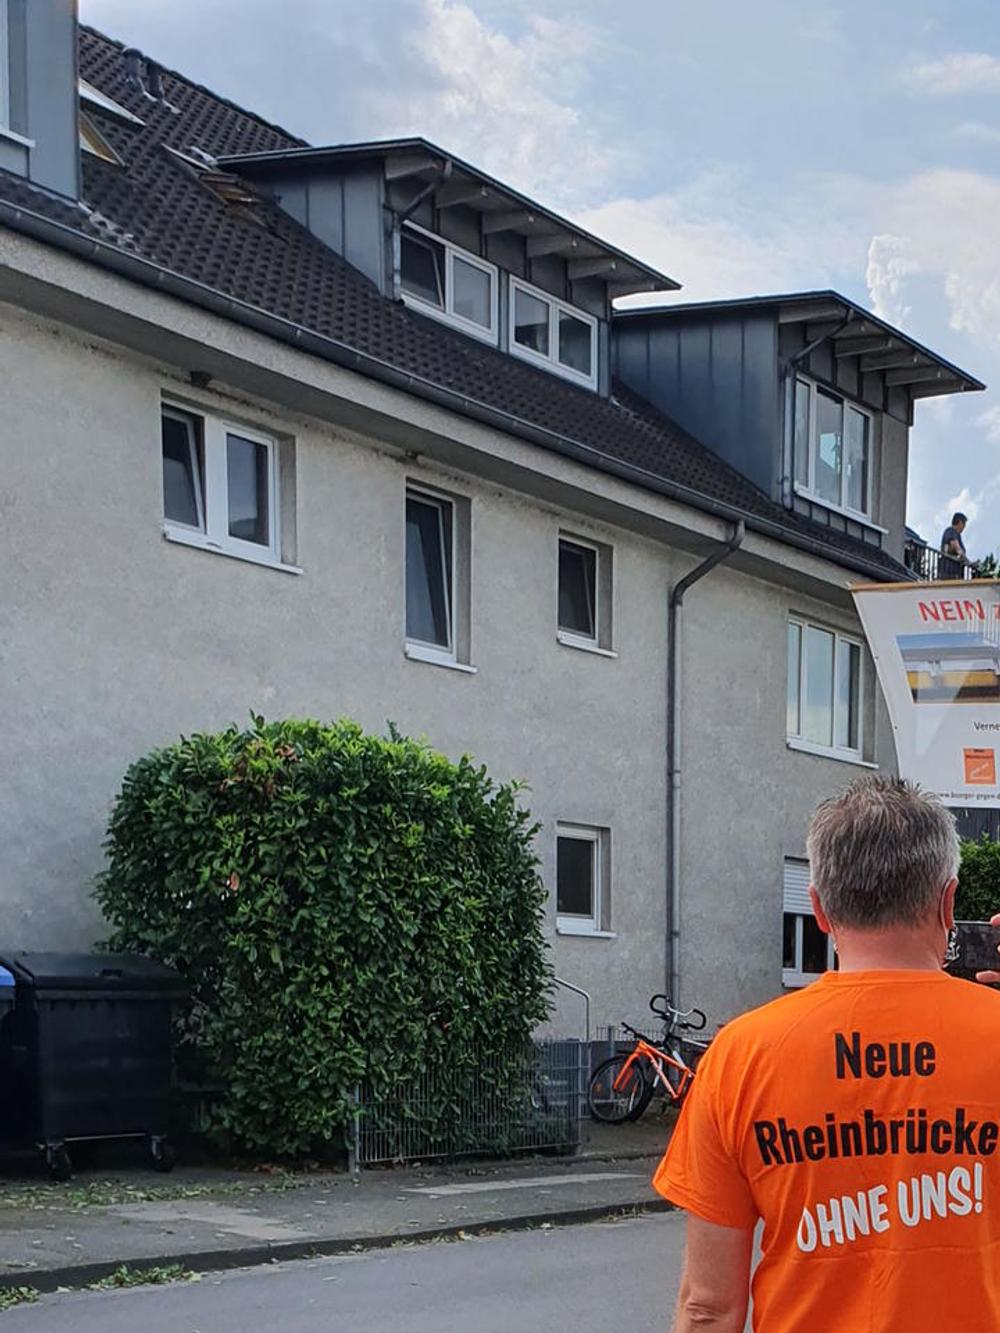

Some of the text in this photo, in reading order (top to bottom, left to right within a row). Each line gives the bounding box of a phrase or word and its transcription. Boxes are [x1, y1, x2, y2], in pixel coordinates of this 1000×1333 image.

[918, 599, 985, 621] NEIN
[834, 1031, 936, 1079] Neue
[796, 1161, 984, 1253] OHNE UNS!
